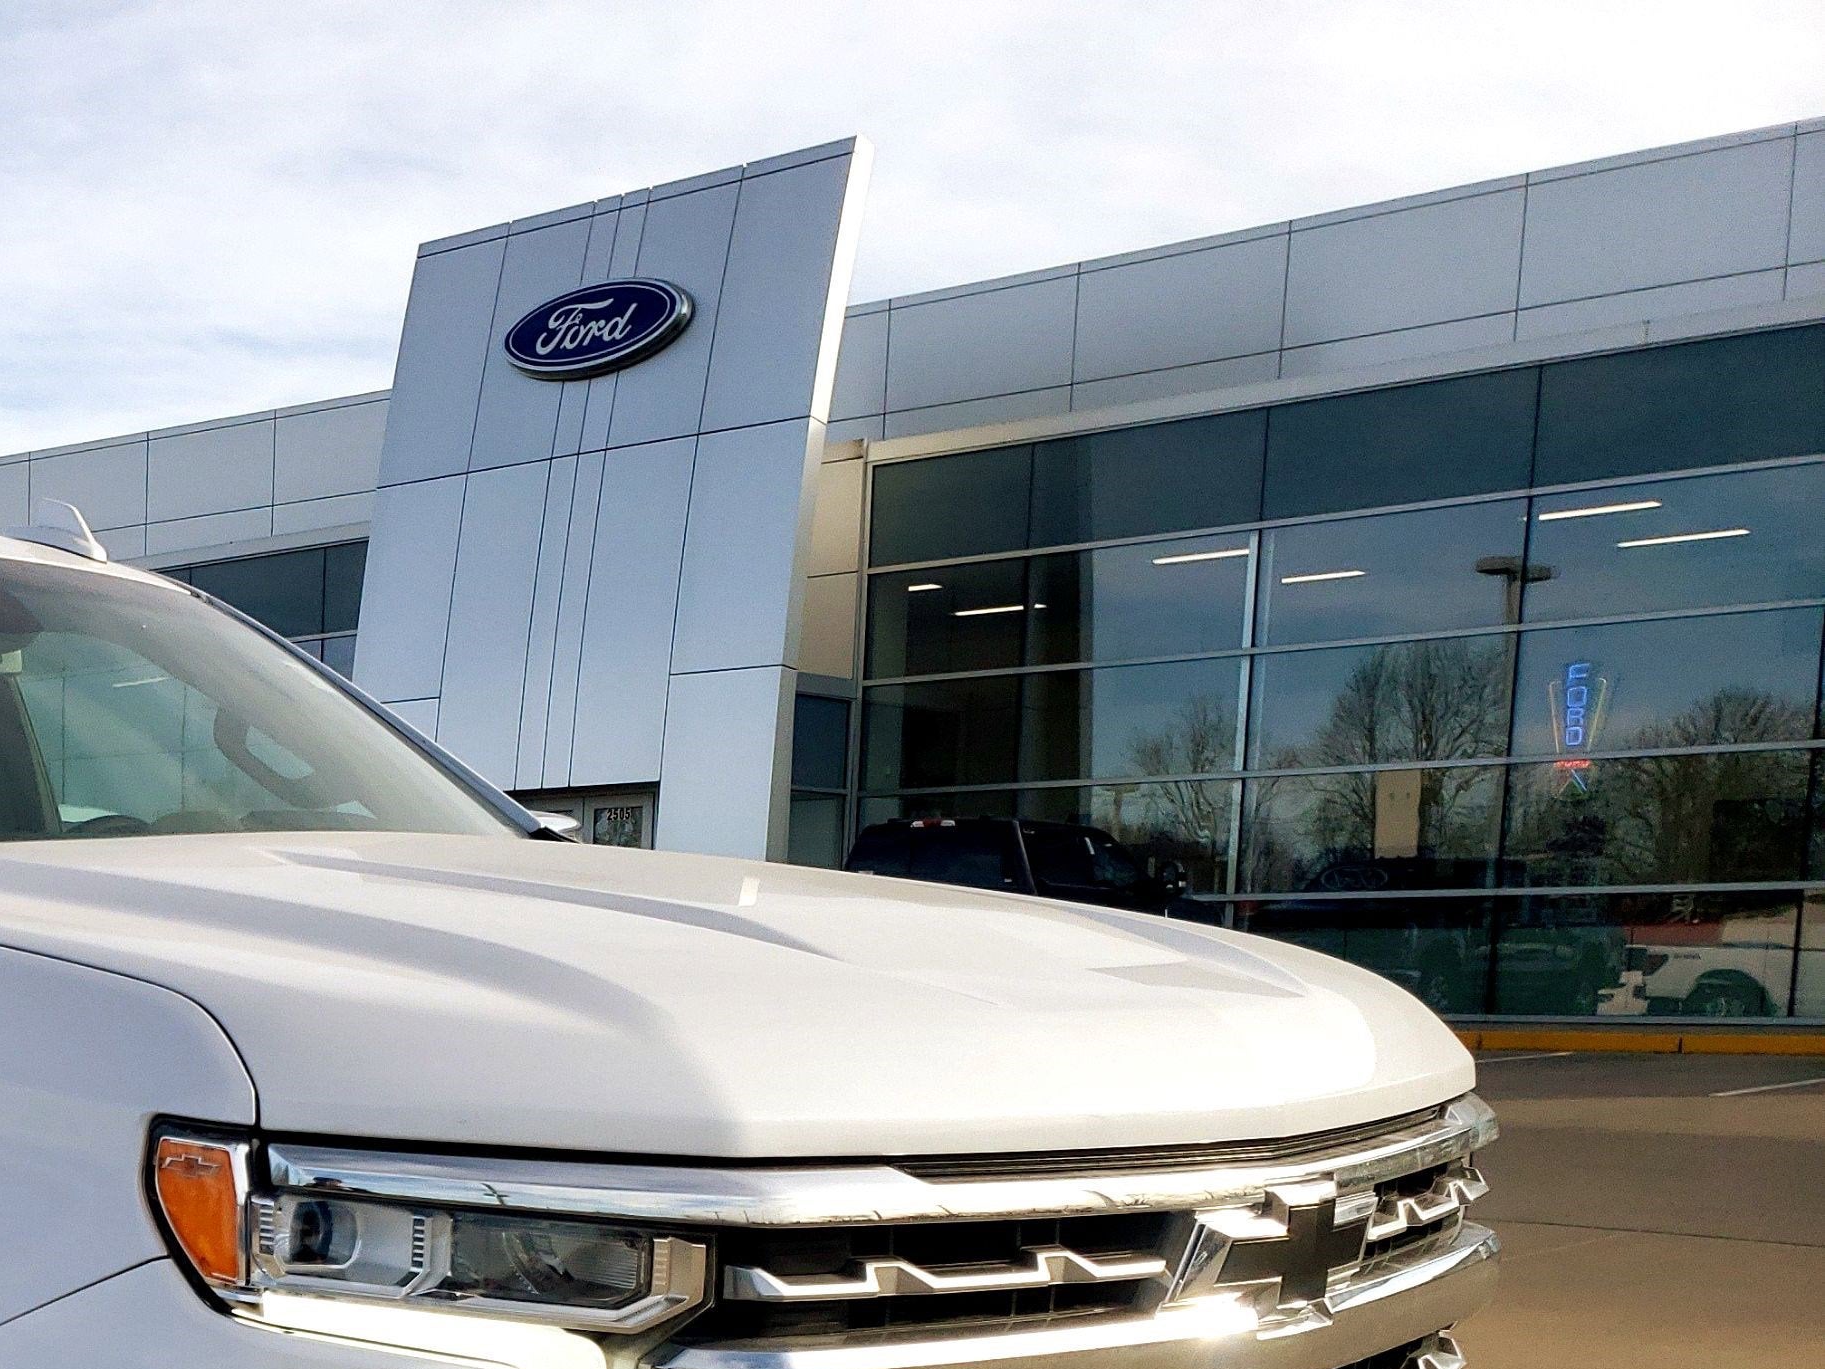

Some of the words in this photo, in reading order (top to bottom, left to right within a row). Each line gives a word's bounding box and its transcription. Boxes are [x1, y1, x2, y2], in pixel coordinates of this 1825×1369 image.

[535, 297, 638, 356] Ford
[1565, 662, 1590, 746] FORD
[606, 808, 632, 821] 2505
